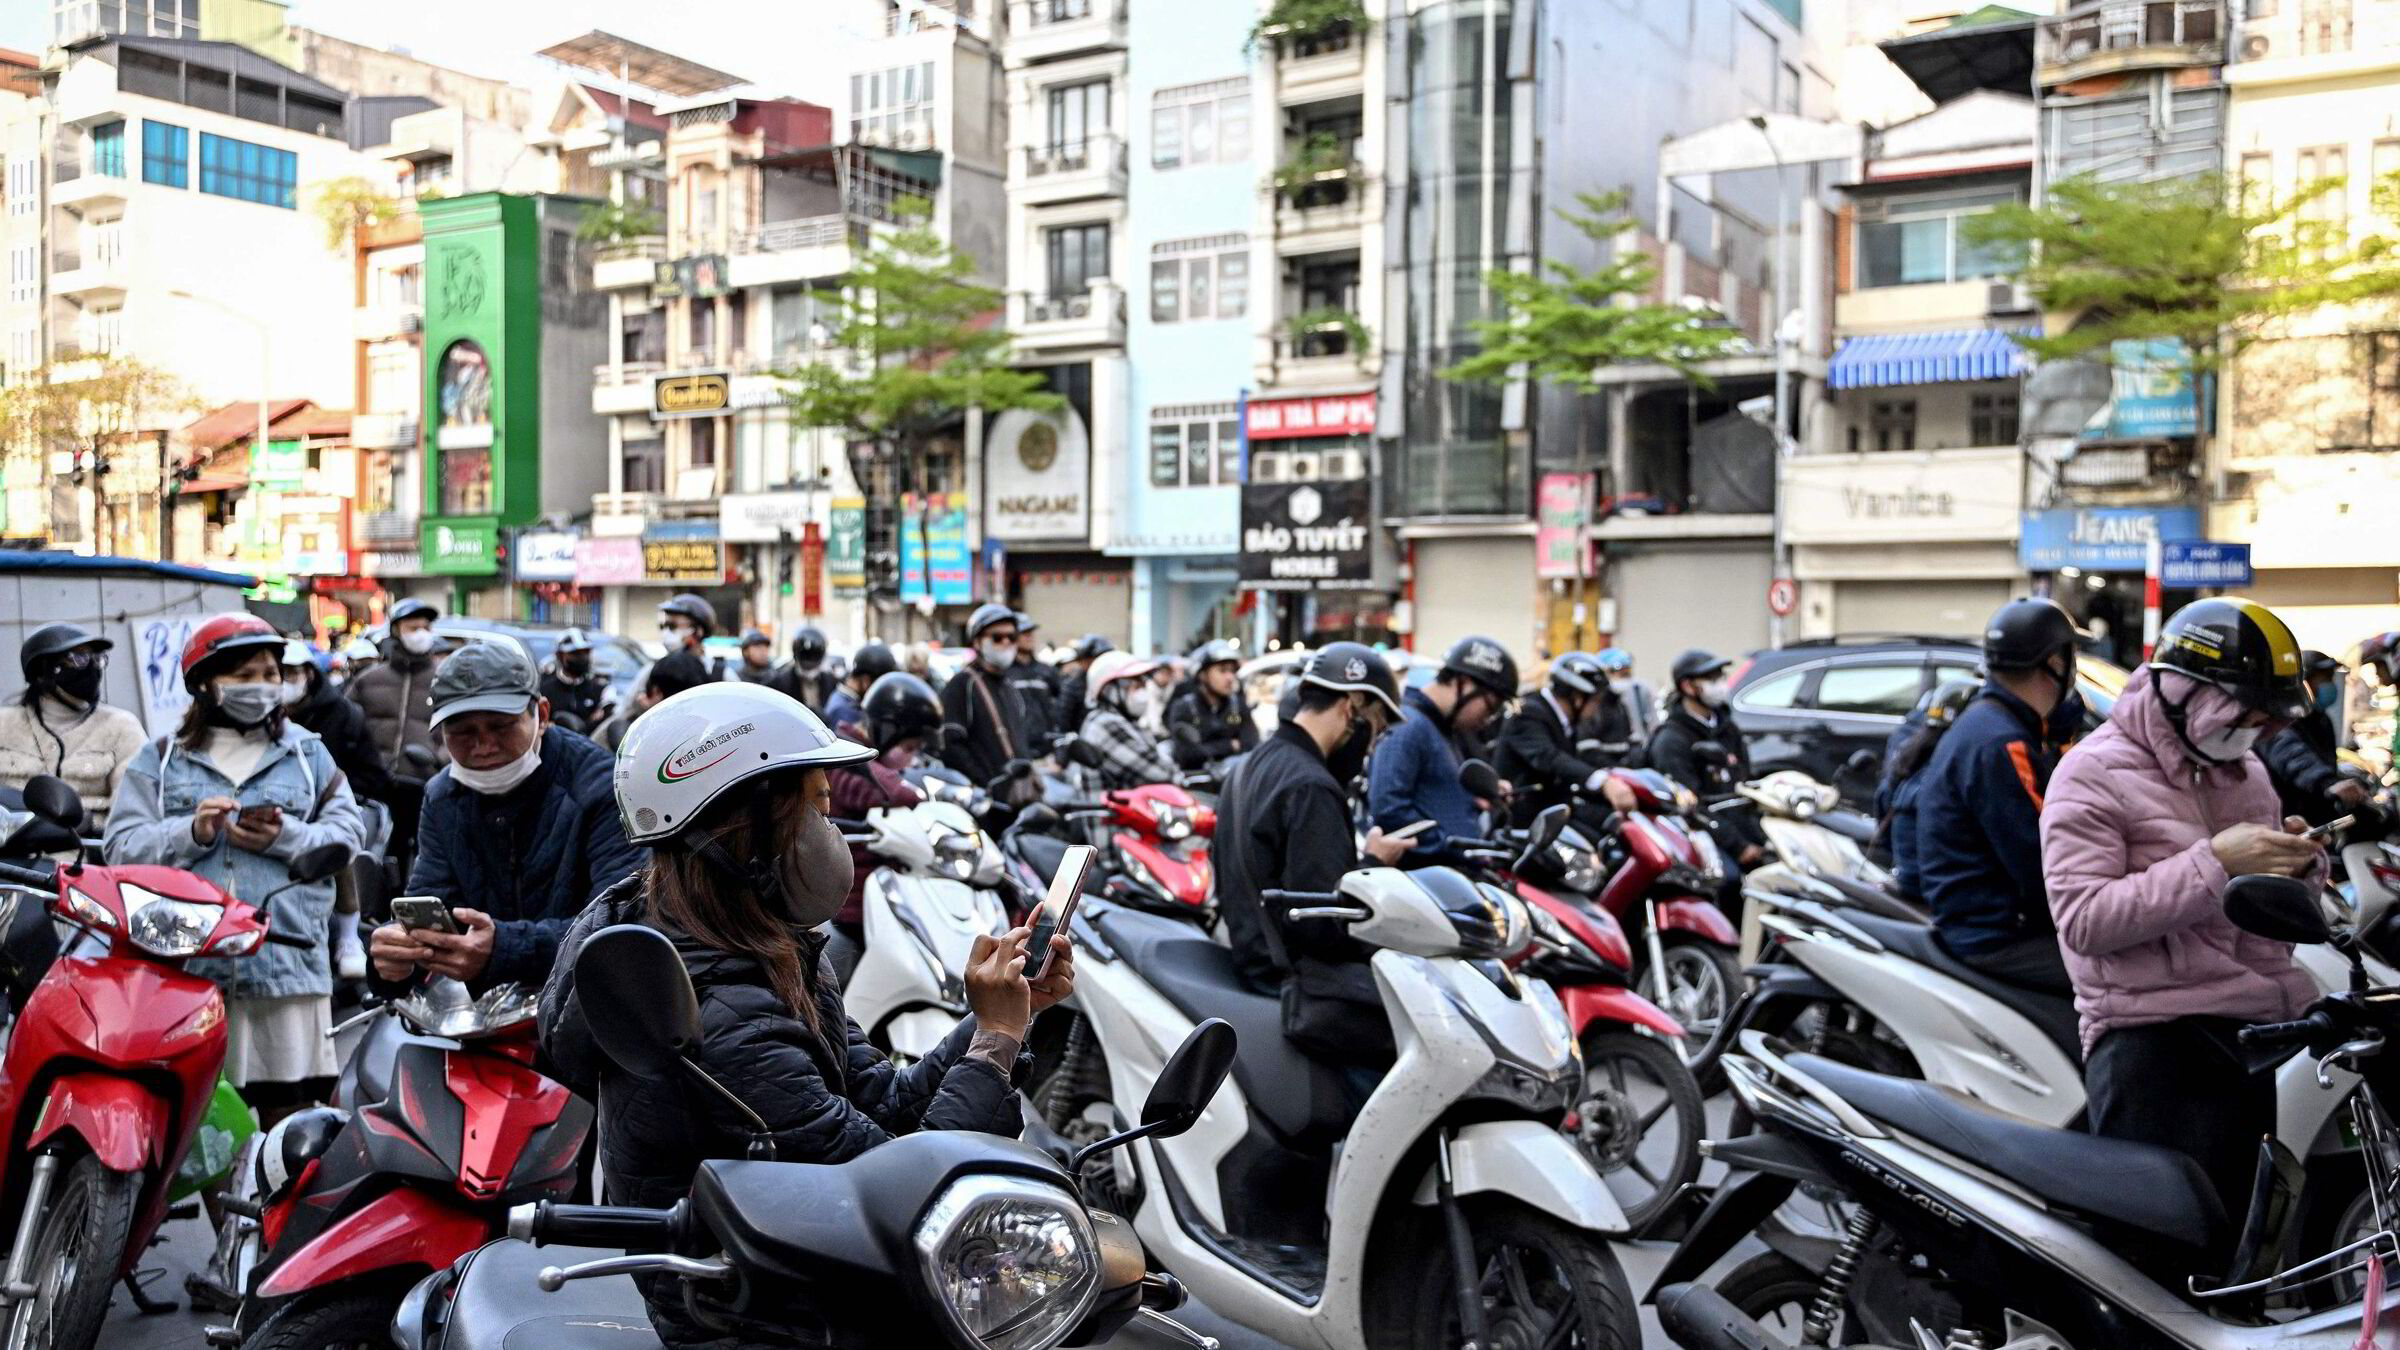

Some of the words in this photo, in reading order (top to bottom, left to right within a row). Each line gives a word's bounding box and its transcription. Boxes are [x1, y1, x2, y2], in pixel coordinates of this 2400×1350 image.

[1270, 556, 1339, 578] MOBILE
[716, 732, 732, 745] XE
[1841, 1150, 1880, 1178] AIR
[1882, 1173, 1968, 1228] BLADE
